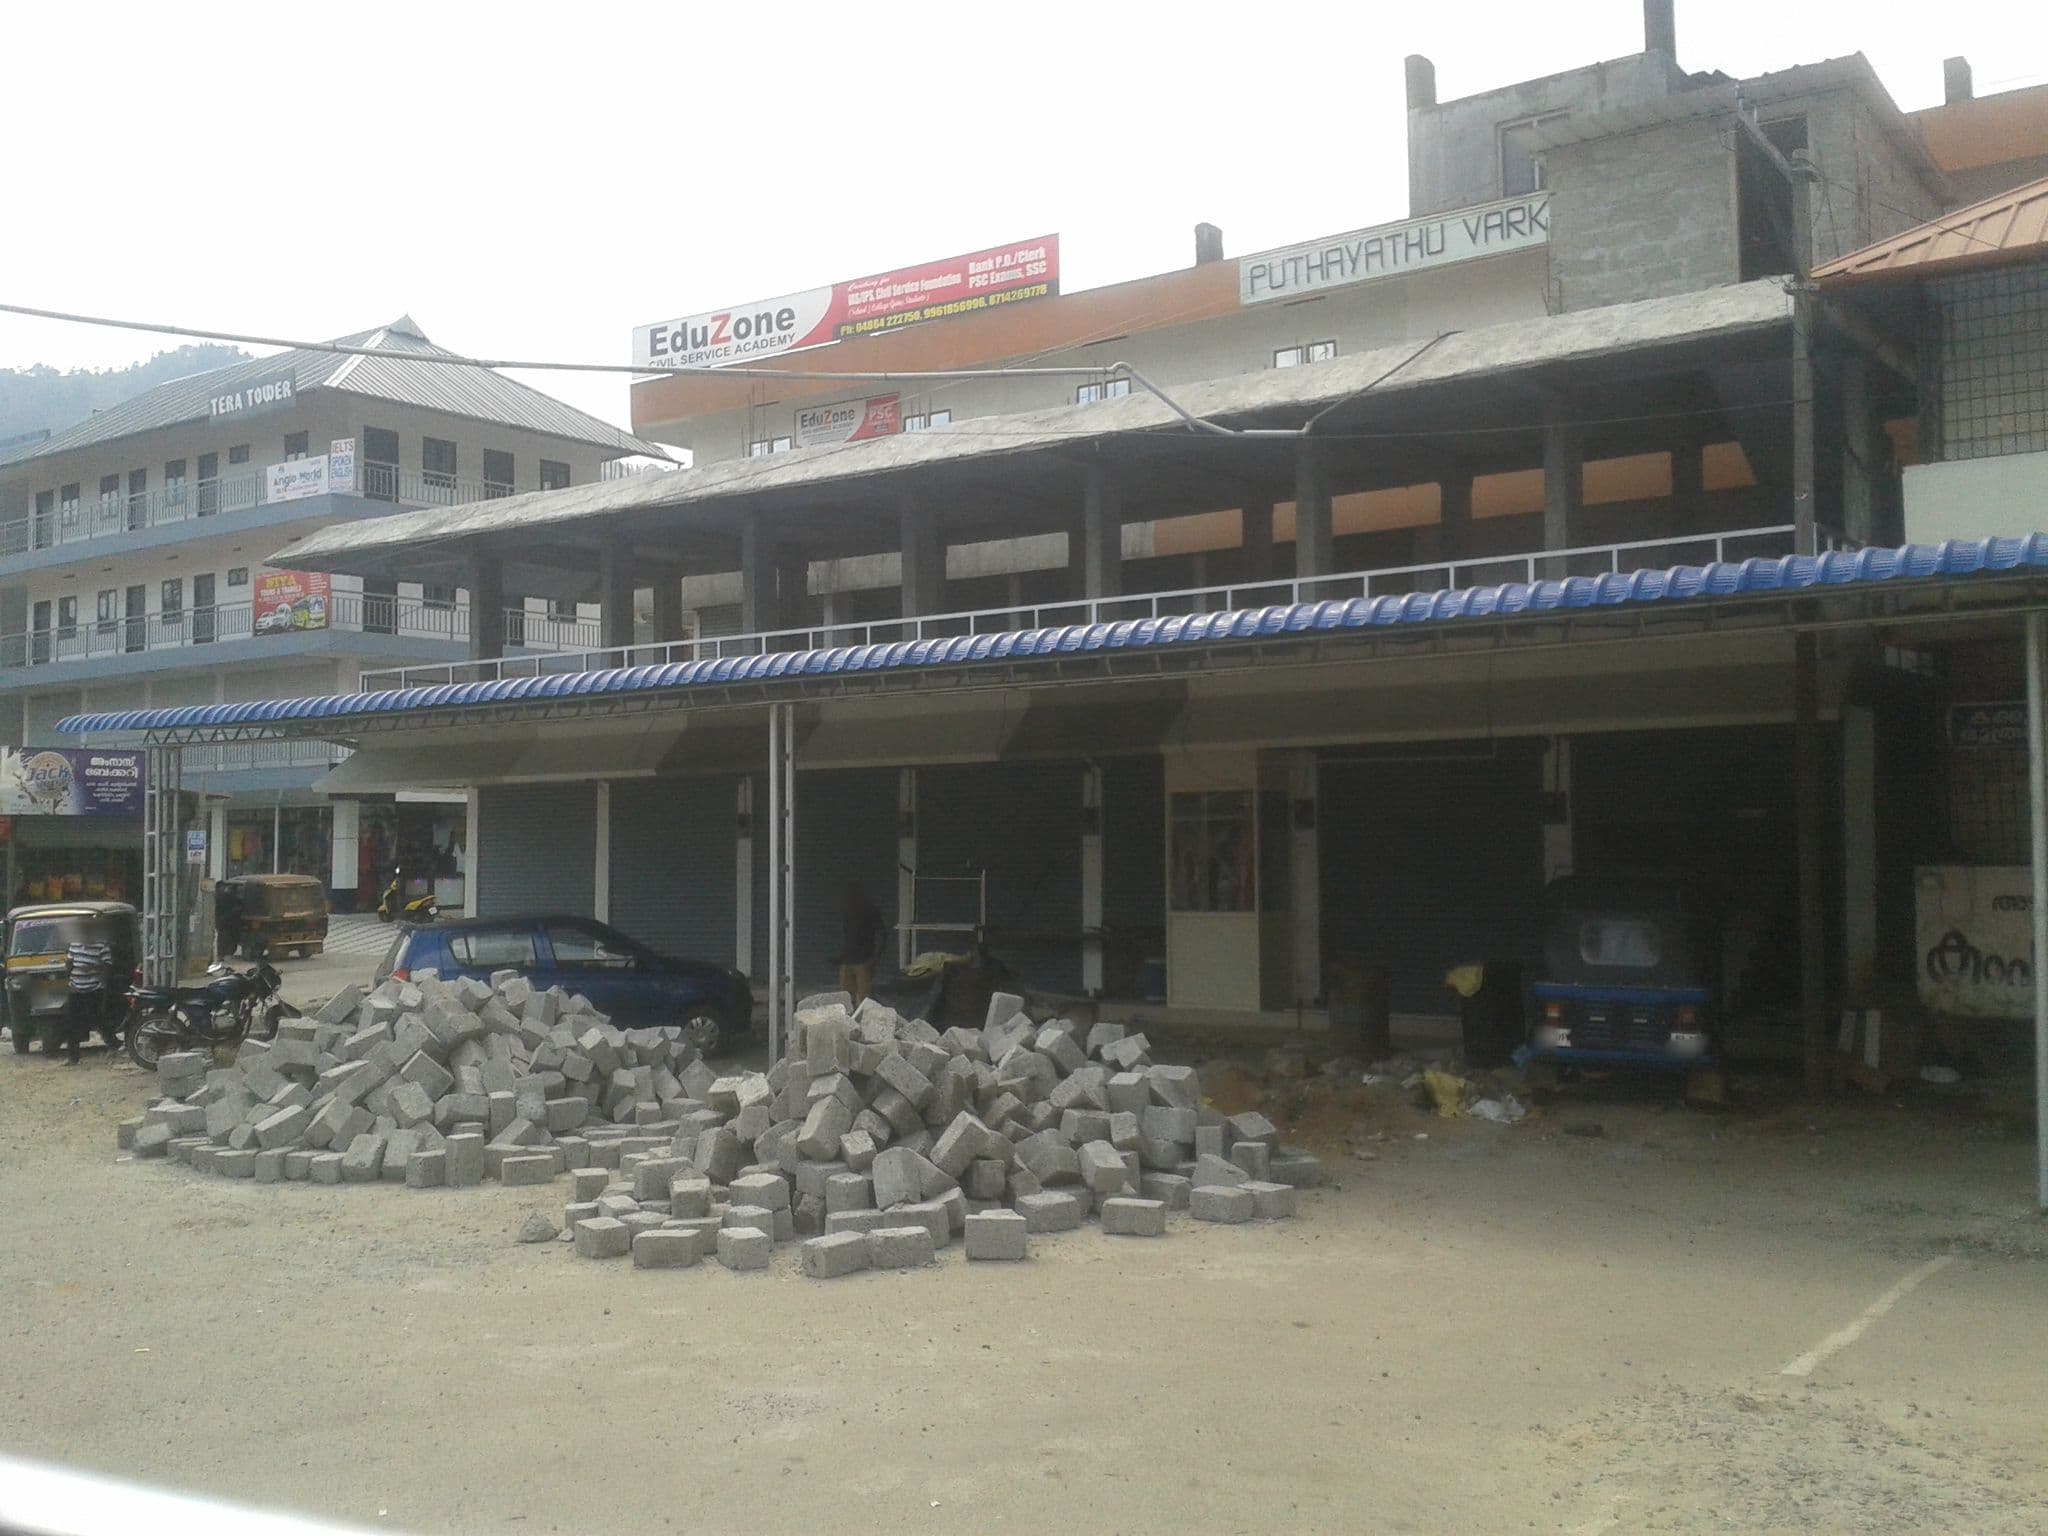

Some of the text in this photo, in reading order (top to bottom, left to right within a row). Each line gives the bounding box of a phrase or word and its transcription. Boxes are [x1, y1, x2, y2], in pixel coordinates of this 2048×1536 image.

[968, 273, 989, 289] PSC
[1026, 260, 1047, 277] SSC
[1250, 223, 1445, 295] PUTHAYATHU
[649, 307, 796, 358] EduZone
[680, 346, 731, 365] SERVICE
[734, 332, 796, 355] ACADEMY
[210, 380, 292, 416] TERA TOWER
[800, 408, 855, 429] EduZone
